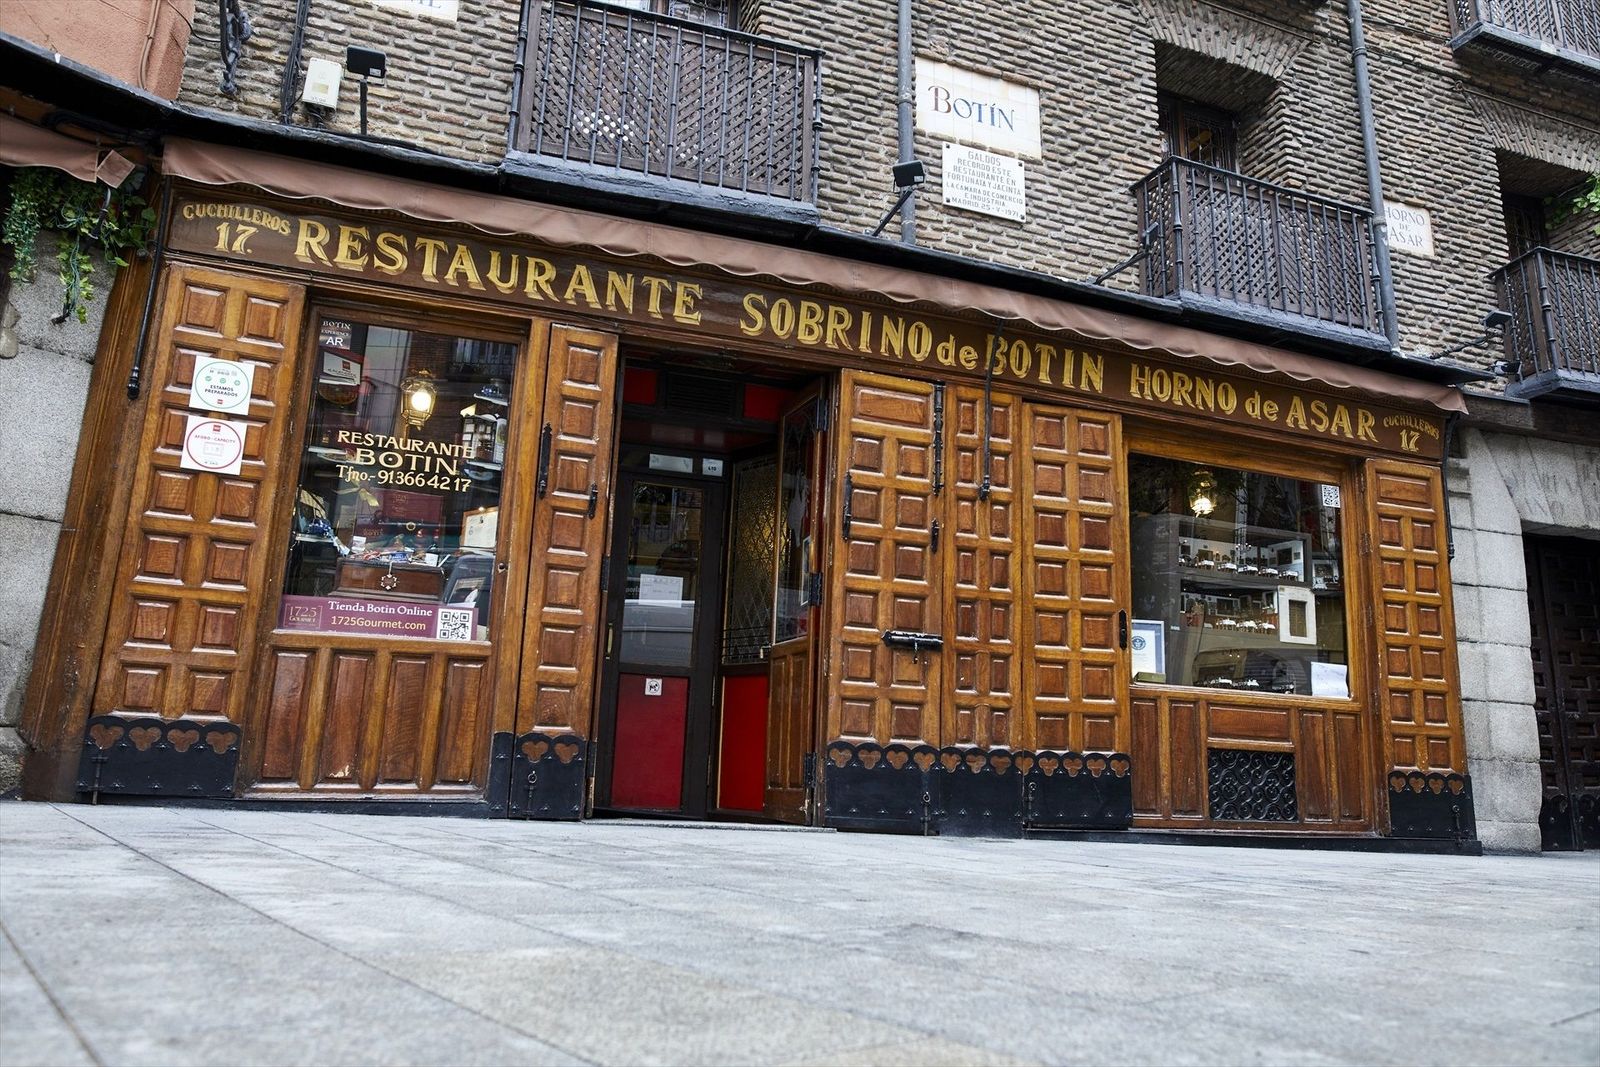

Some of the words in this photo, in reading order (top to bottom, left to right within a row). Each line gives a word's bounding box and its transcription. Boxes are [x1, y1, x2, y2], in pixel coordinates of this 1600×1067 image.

[927, 85, 1015, 132] BOTÍN
[953, 165, 1004, 184] RESTAURANTE
[1006, 177, 1016, 187] EN
[992, 166, 1012, 178] ESTE
[947, 171, 987, 187] FORTUNATA
[987, 181, 992, 189] Y
[992, 183, 1021, 196] JACINTA
[970, 193, 1006, 207] INDUSTRIA
[183, 203, 291, 236] CUCHILLEROS
[1390, 226, 1425, 249] ASAR
[294, 218, 704, 326] RESTAURANTE
[739, 292, 933, 362] SOBRINO
[936, 334, 979, 370] de
[985, 334, 1105, 394] BOTIN
[1129, 363, 1238, 415] HORNO
[1245, 390, 1280, 421] de
[1286, 395, 1379, 443] ASAR
[322, 320, 351, 330] BOTIN
[325, 336, 345, 347] AR
[204, 388, 238, 397] PREPARADOS
[210, 384, 234, 392] ESTAMOS
[1383, 415, 1440, 440] CUCHILLEROS
[337, 430, 475, 460] RESTAURANTE
[355, 447, 459, 476] BOTIN
[289, 606, 317, 618] 1725
[327, 600, 365, 612] Tienda
[366, 603, 396, 614] Botin
[397, 605, 433, 617] Online
[331, 616, 427, 631] 1725Gourmet.com
